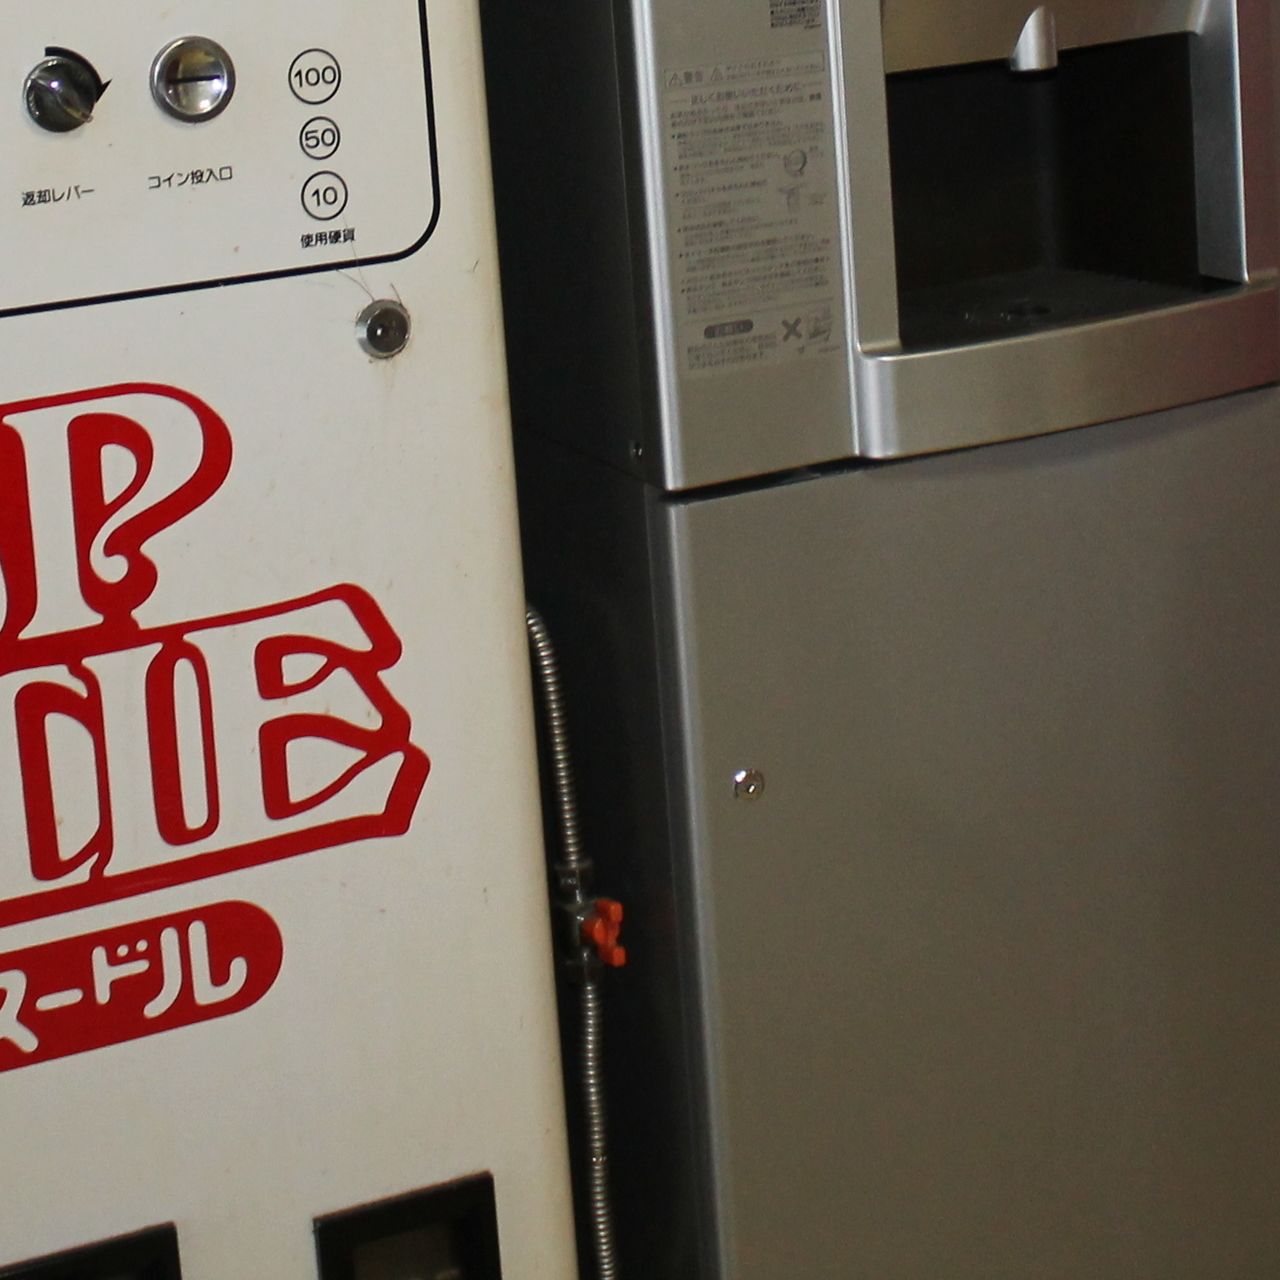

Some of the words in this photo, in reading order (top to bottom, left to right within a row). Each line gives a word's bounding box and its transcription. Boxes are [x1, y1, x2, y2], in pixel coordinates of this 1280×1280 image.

[293, 66, 337, 88] 100
[303, 127, 336, 149] 50
[148, 165, 234, 191] コイン投入口
[21, 182, 96, 208] 返却レバー
[310, 185, 338, 207] 10
[299, 227, 356, 249] 使用硬貨
